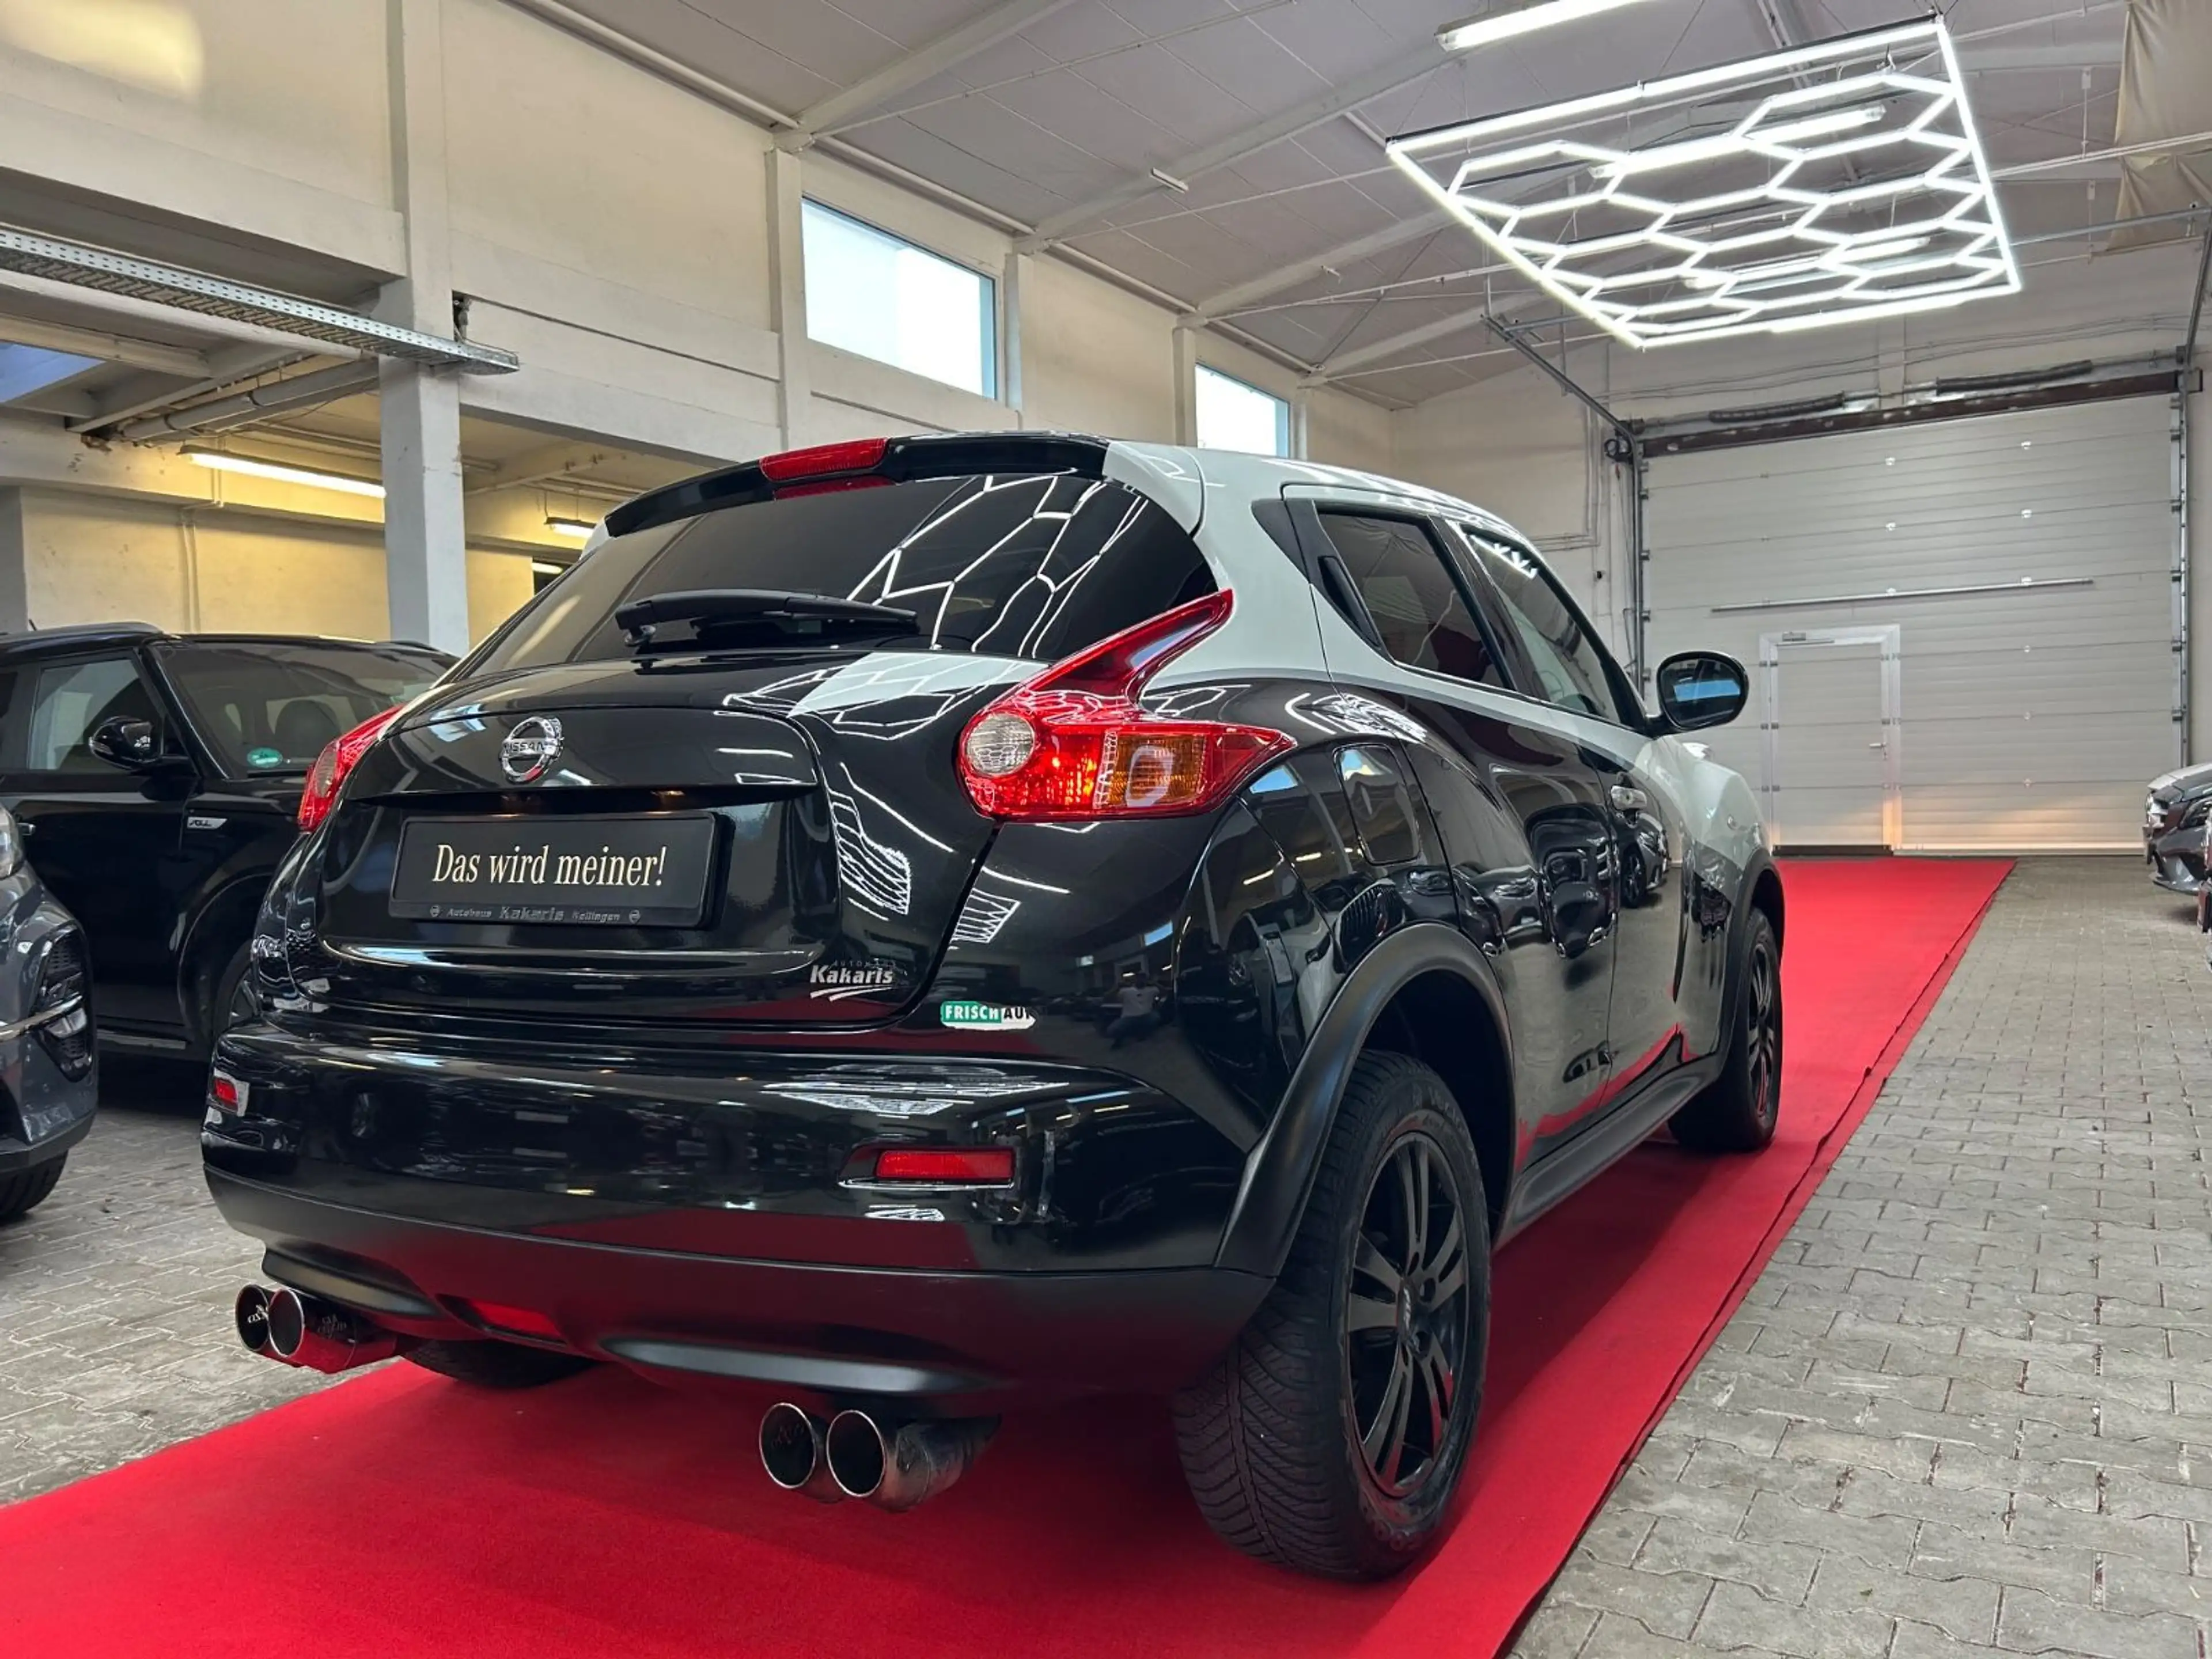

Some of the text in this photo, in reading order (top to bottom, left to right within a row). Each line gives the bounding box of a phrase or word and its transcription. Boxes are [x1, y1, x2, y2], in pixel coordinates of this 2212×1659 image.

[503, 741, 545, 753] NISSAN
[432, 844, 667, 886] Das wird meiner!
[499, 906, 565, 921] Kakaris
[810, 964, 893, 984] Kakaris
[945, 1005, 999, 1020] FRISCH
